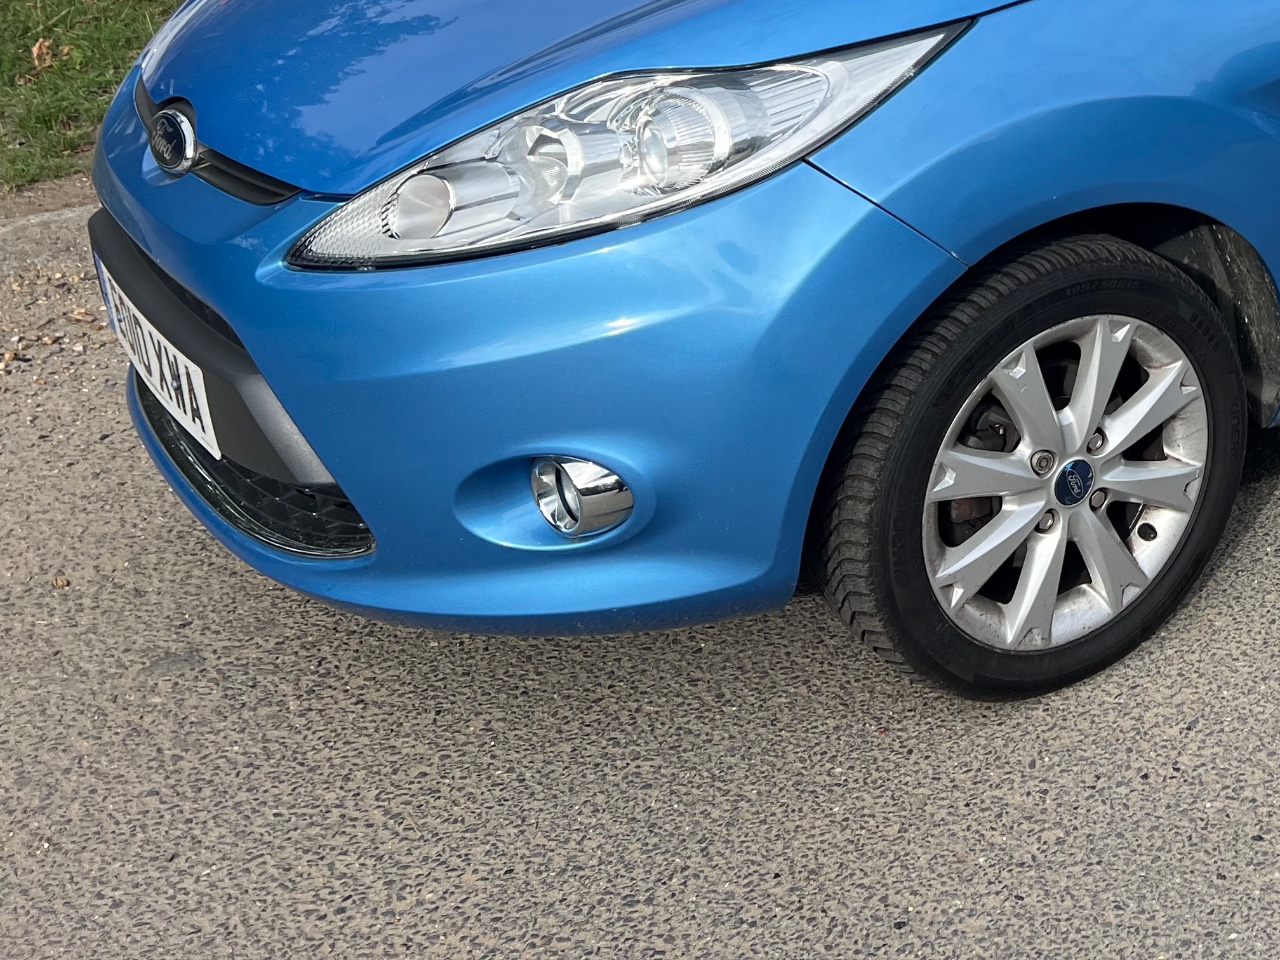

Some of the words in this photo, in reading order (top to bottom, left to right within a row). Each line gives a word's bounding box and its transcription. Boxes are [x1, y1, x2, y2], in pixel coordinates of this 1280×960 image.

[151, 118, 177, 160] Ford
[148, 330, 206, 435] XWA
[1068, 474, 1081, 495] Ford
